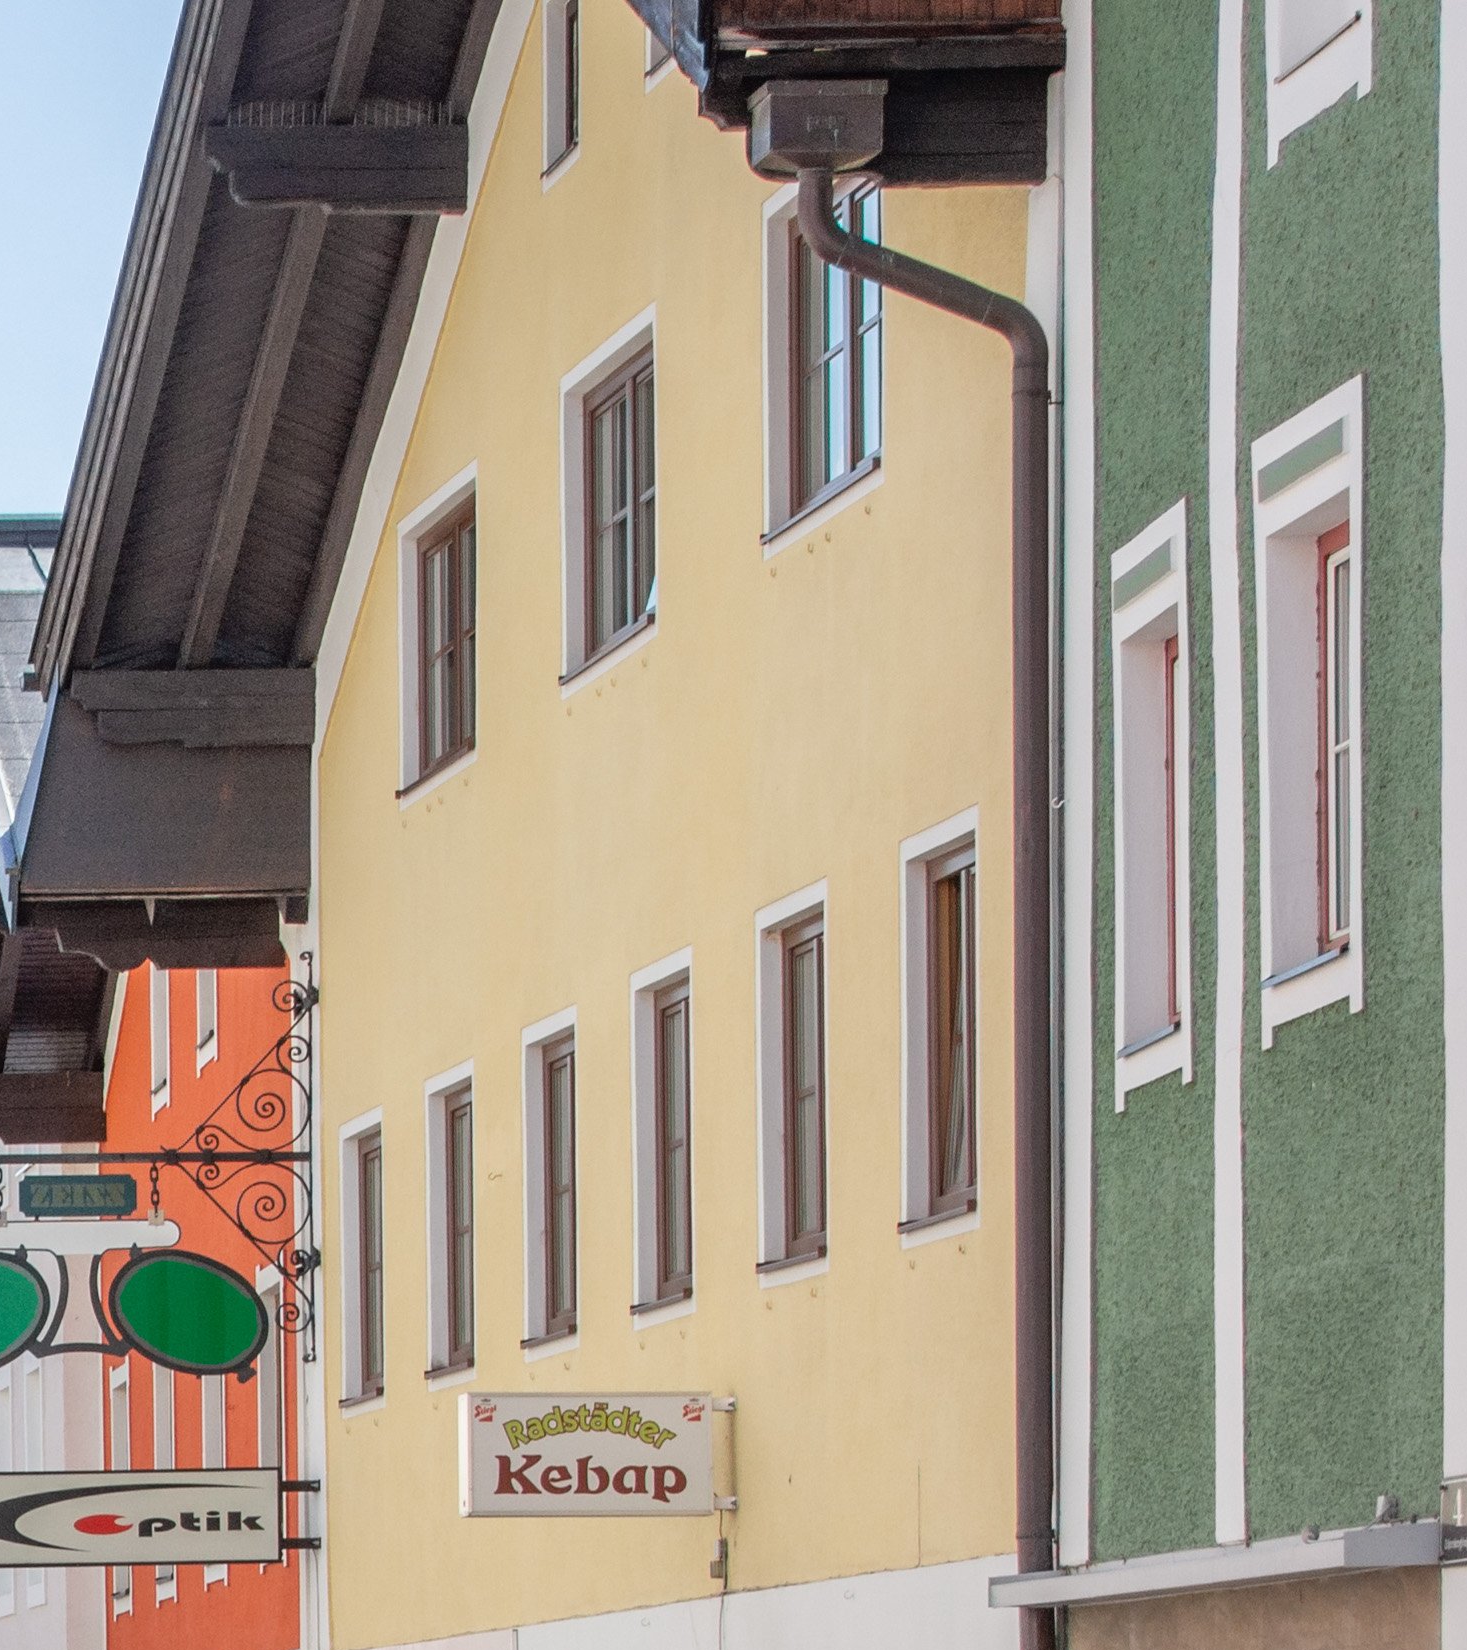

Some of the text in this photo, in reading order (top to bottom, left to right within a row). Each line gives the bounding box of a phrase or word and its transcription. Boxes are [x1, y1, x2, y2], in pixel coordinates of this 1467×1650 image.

[30, 1183, 125, 1208] ZEISS
[502, 1402, 677, 1450] Radstädter
[494, 1454, 687, 1503] Kebap
